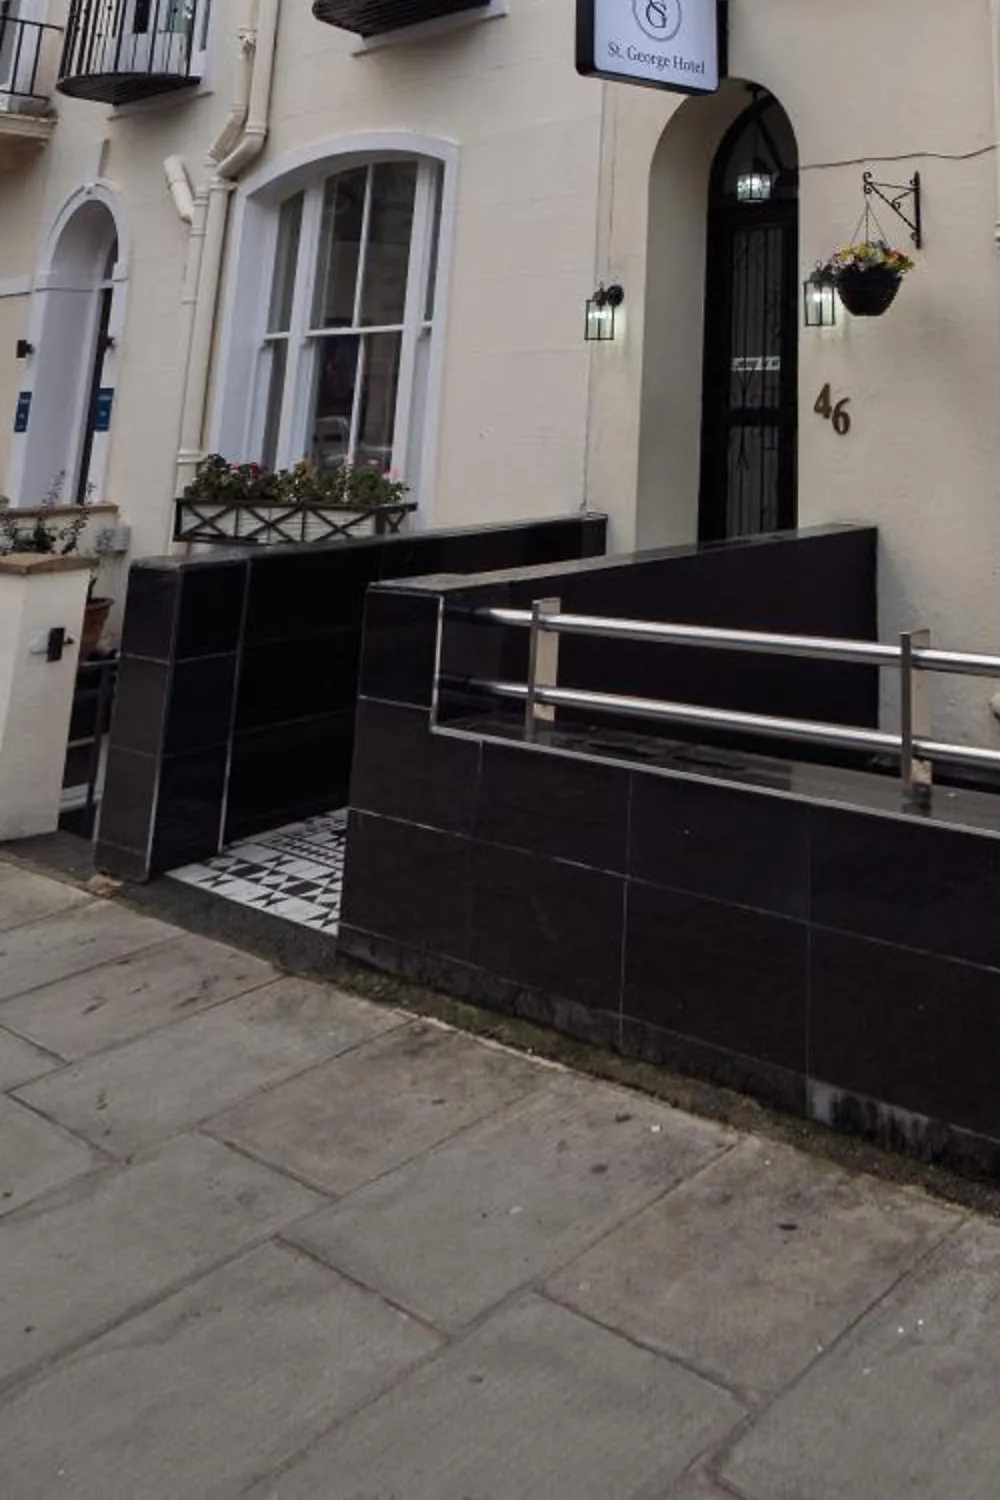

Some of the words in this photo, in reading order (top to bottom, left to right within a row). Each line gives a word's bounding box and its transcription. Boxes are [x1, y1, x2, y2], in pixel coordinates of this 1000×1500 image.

[627, 45, 671, 71] George
[673, 55, 706, 75] Hotel
[813, 382, 851, 436] 46
